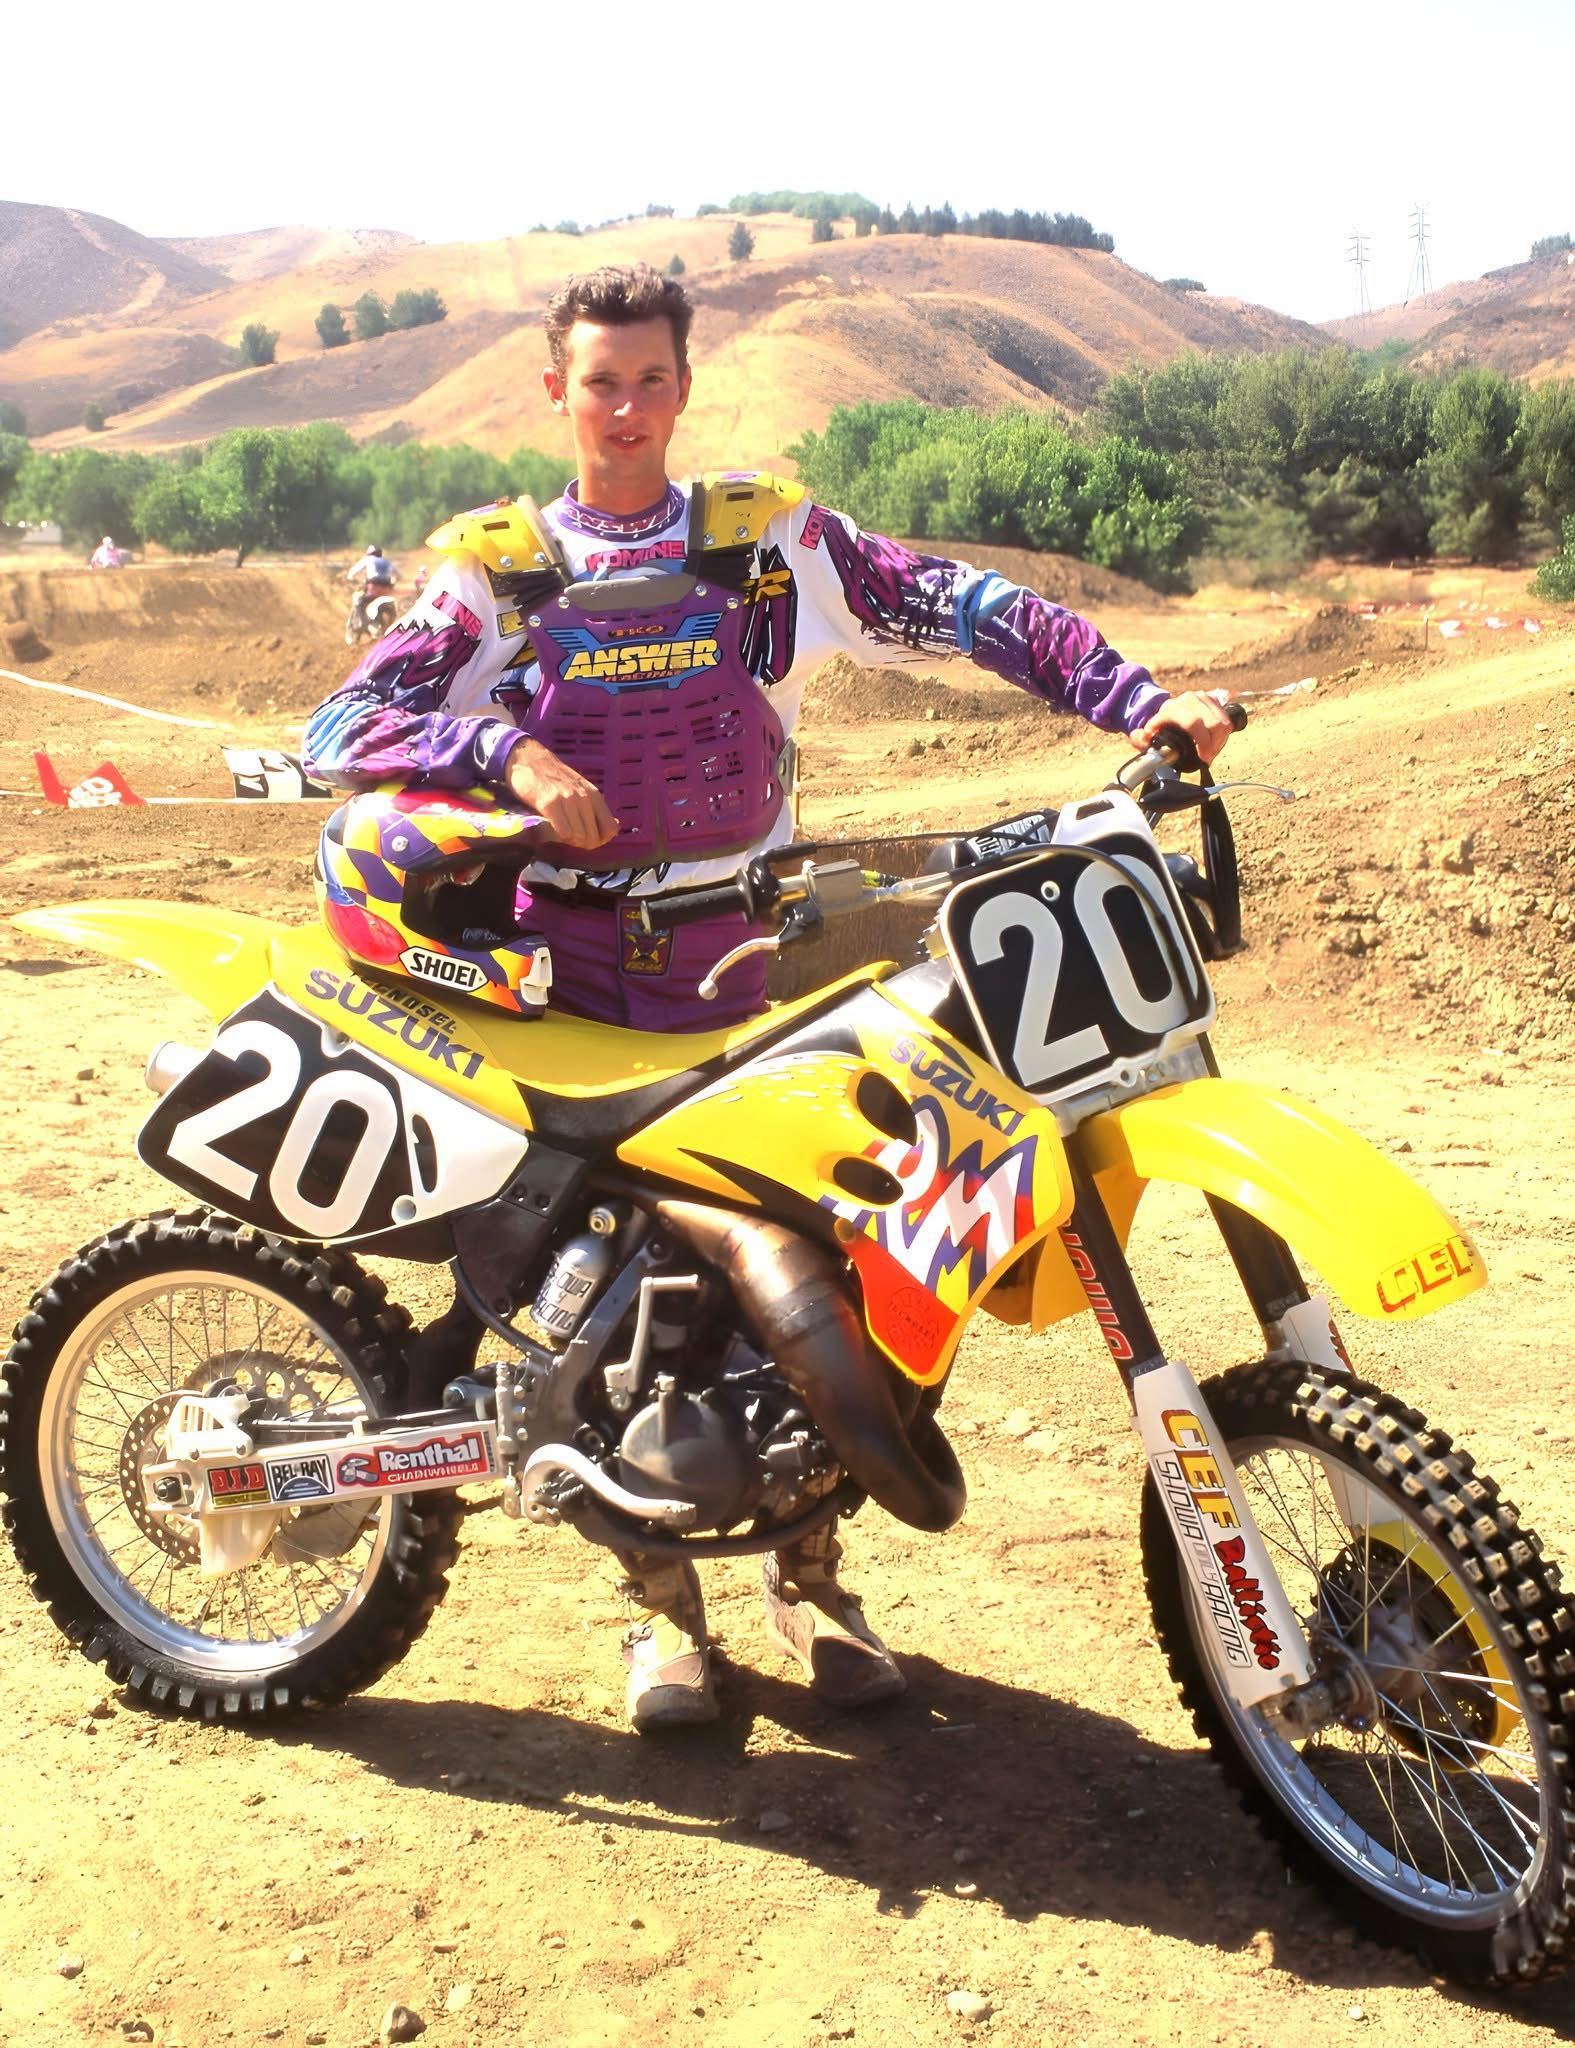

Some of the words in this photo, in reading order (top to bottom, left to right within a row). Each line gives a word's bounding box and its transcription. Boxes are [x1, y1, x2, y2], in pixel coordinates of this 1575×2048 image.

[585, 540, 688, 574] KOMINE
[563, 639, 718, 680] ANSWER
[409, 951, 478, 988] SHOEI
[970, 853, 1198, 1087] 20
[304, 968, 485, 1080] SUZUKI
[167, 1019, 398, 1238] 20
[889, 1036, 1026, 1137] SUZUKI
[378, 1438, 480, 1472] Renthal
[1156, 1458, 1204, 1541] SHOWA
[1201, 1580, 1249, 1665] RACING
